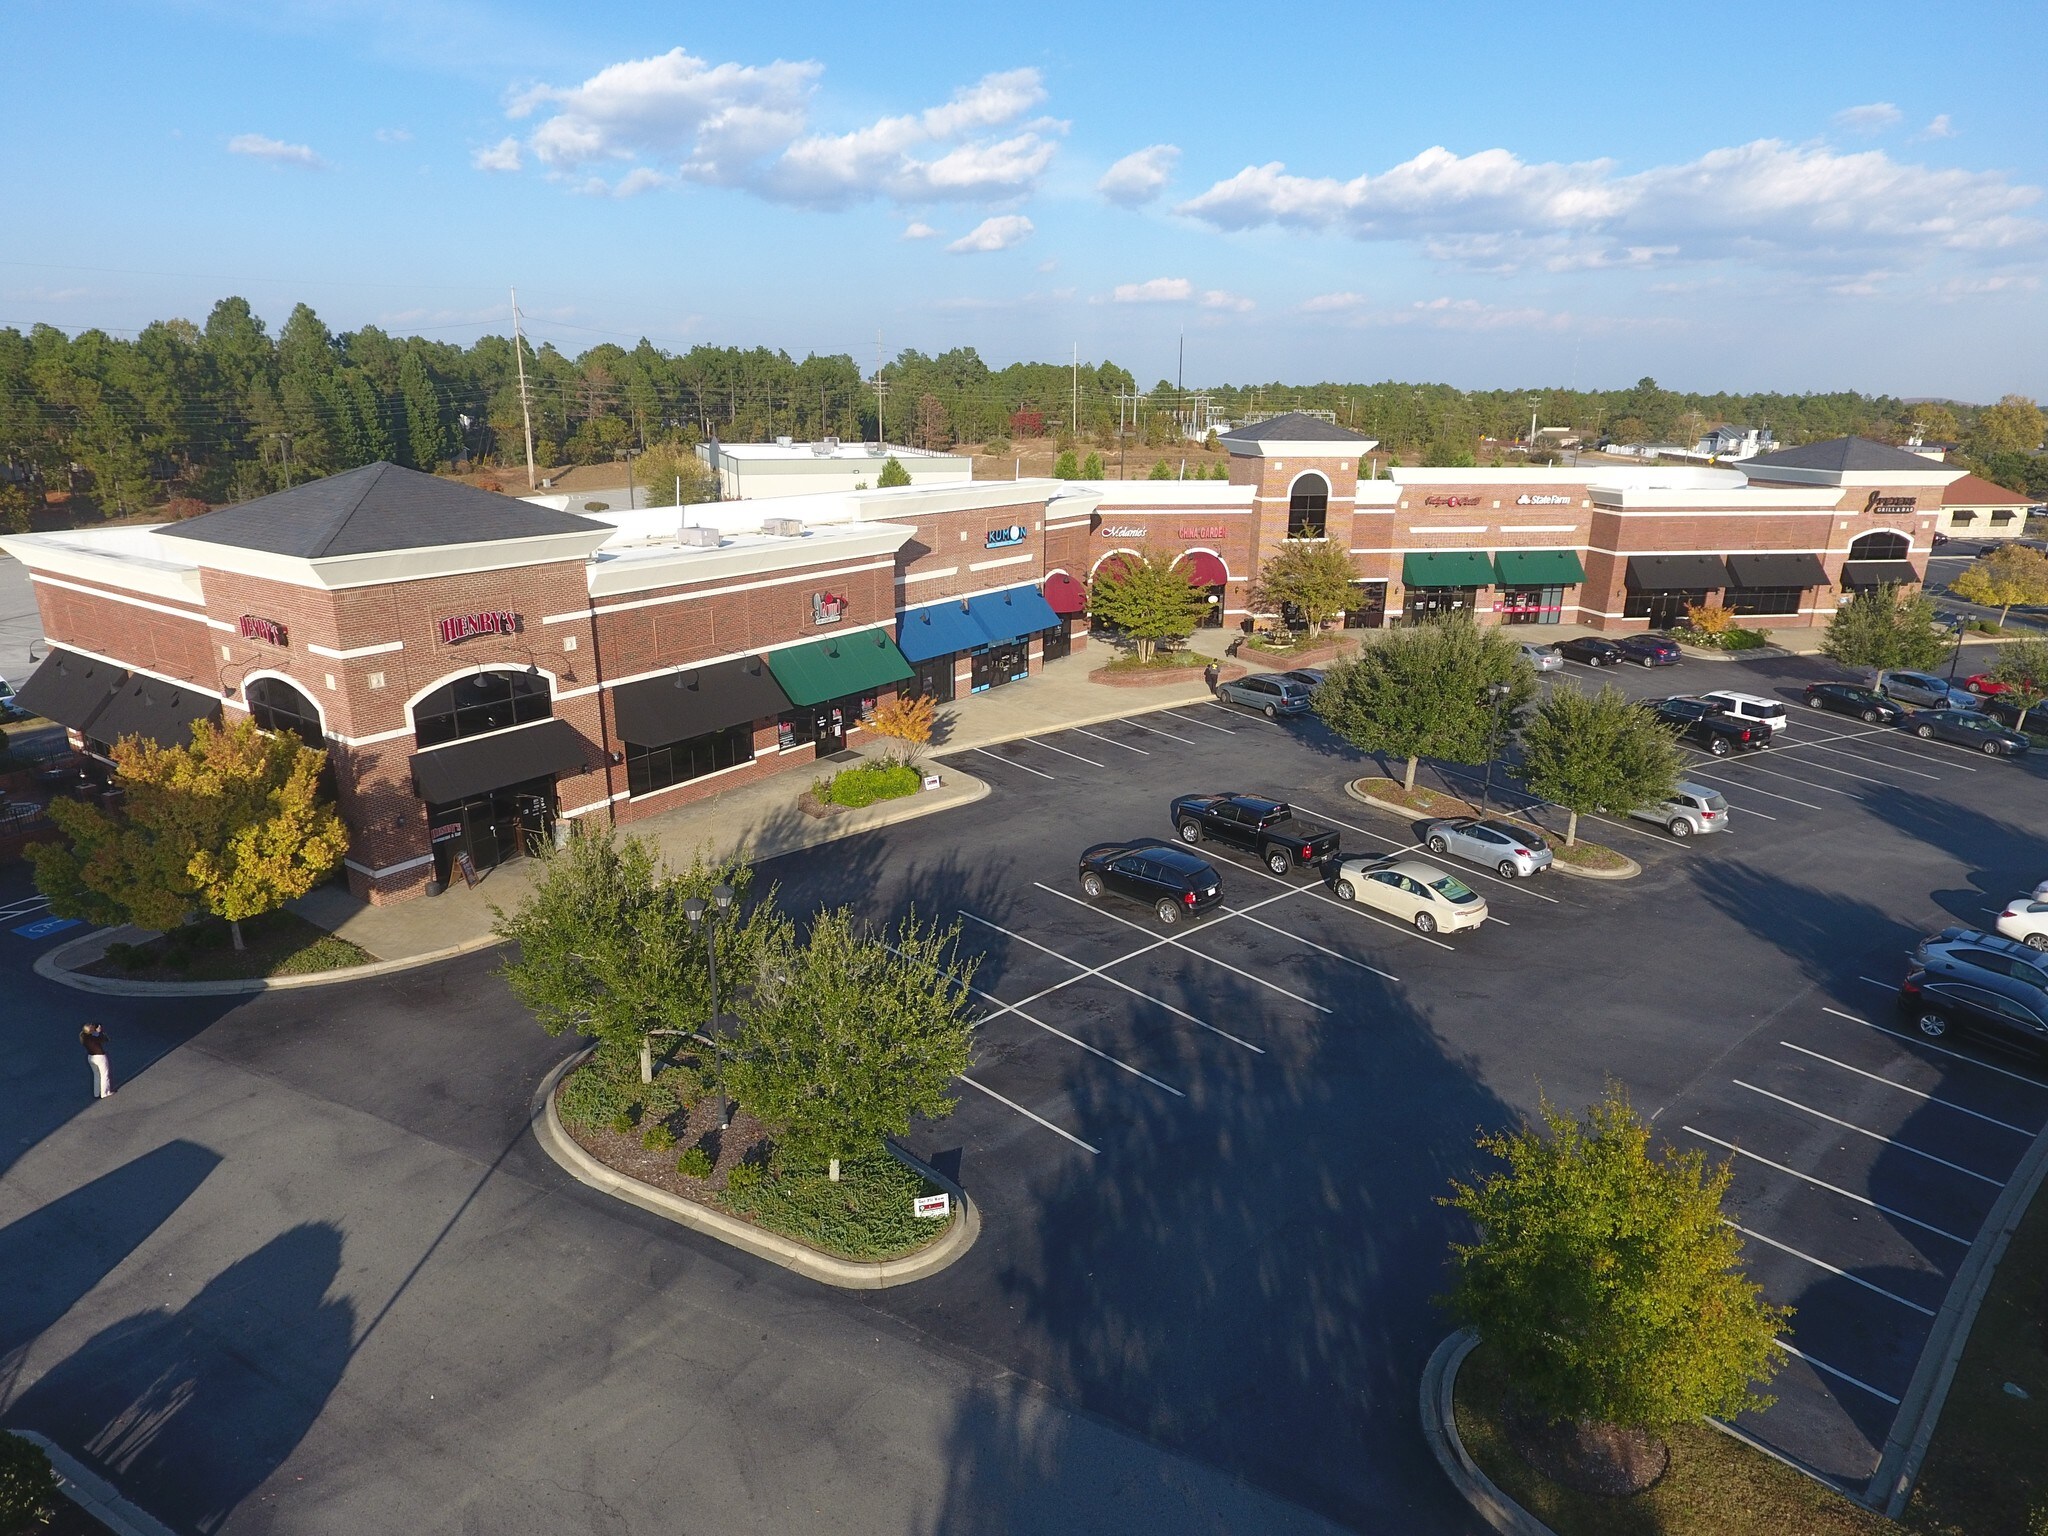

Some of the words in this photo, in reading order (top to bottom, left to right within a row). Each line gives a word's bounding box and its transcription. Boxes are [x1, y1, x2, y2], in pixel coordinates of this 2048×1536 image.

[988, 525, 1027, 543] KUMON
[1101, 525, 1147, 538] Melanie's
[1178, 526, 1199, 540] CHINA
[1200, 526, 1228, 539] GARDEN
[239, 614, 281, 647] HENRY'S
[441, 611, 516, 644] HENRY'S
